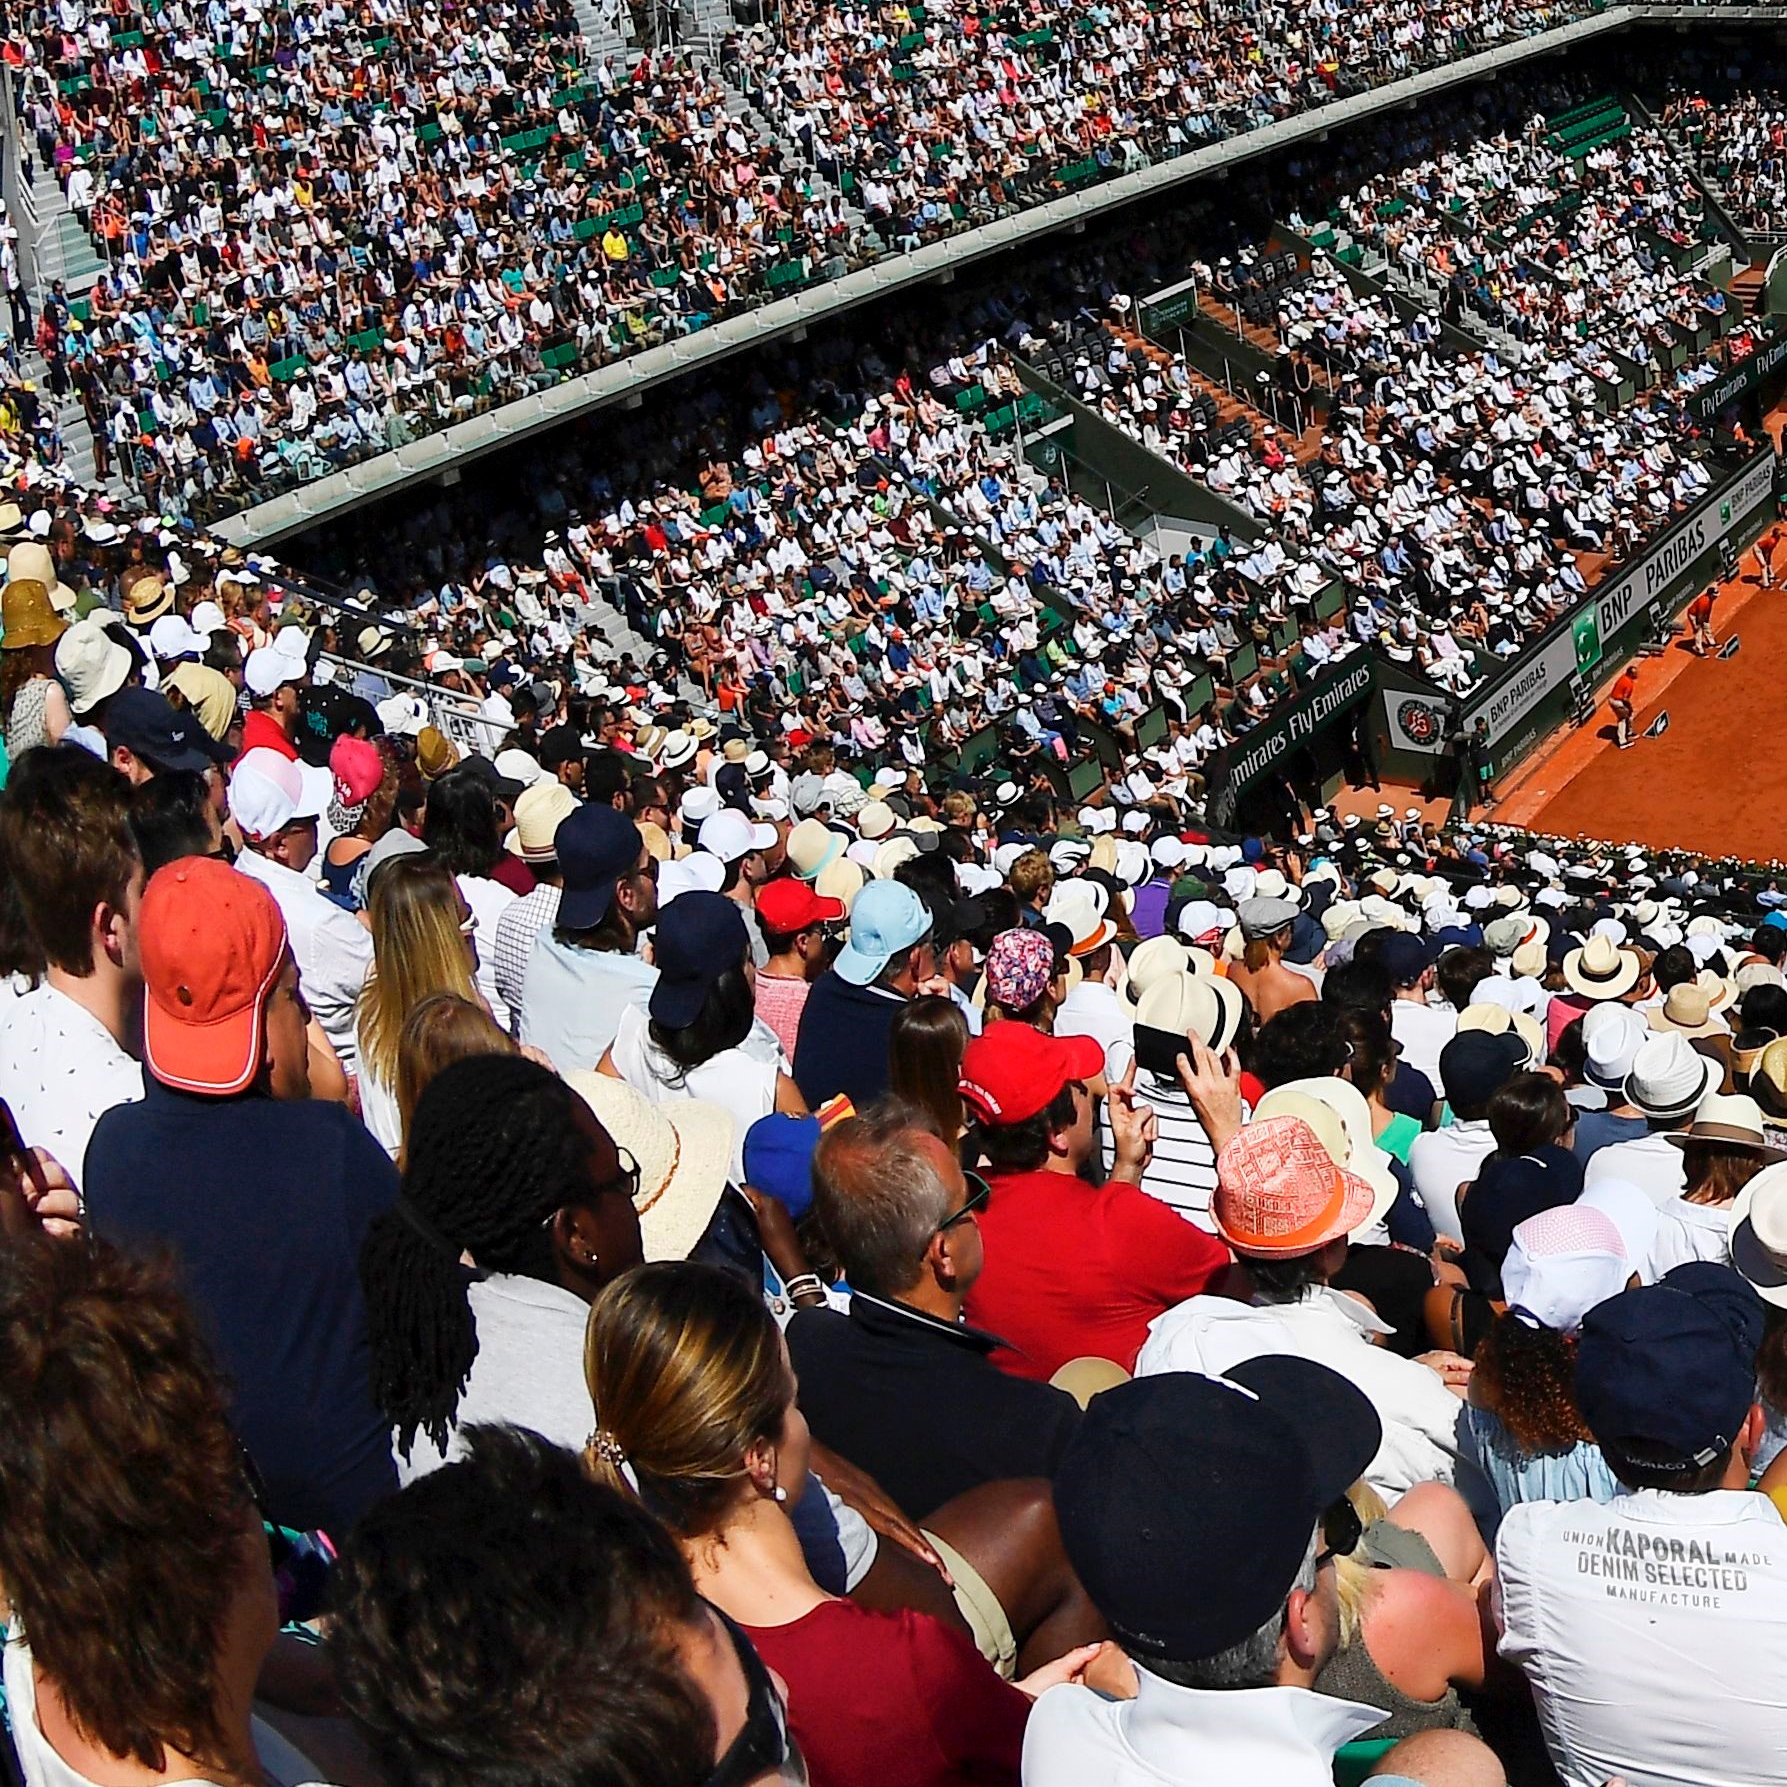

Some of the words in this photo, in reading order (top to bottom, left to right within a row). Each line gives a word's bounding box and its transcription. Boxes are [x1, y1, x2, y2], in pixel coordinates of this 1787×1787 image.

[1701, 393, 1716, 417] Fly
[1715, 372, 1748, 402] Emirates
[1600, 583, 1633, 634] BNP
[1645, 520, 1705, 595] PARIBAS
[1289, 708, 1313, 740] Fly
[1312, 663, 1370, 722] Emirates
[1490, 694, 1510, 723] BNP
[1509, 662, 1547, 705] PARIBAS
[1563, 1530, 1604, 1547] UNION
[1606, 1526, 1721, 1566] KAPORAL
[1725, 1551, 1773, 1567] MADE
[1577, 1551, 1640, 1582] DENIM
[1645, 1564, 1748, 1592] SELECTED
[1606, 1585, 1722, 1610] MANUFACTURE
